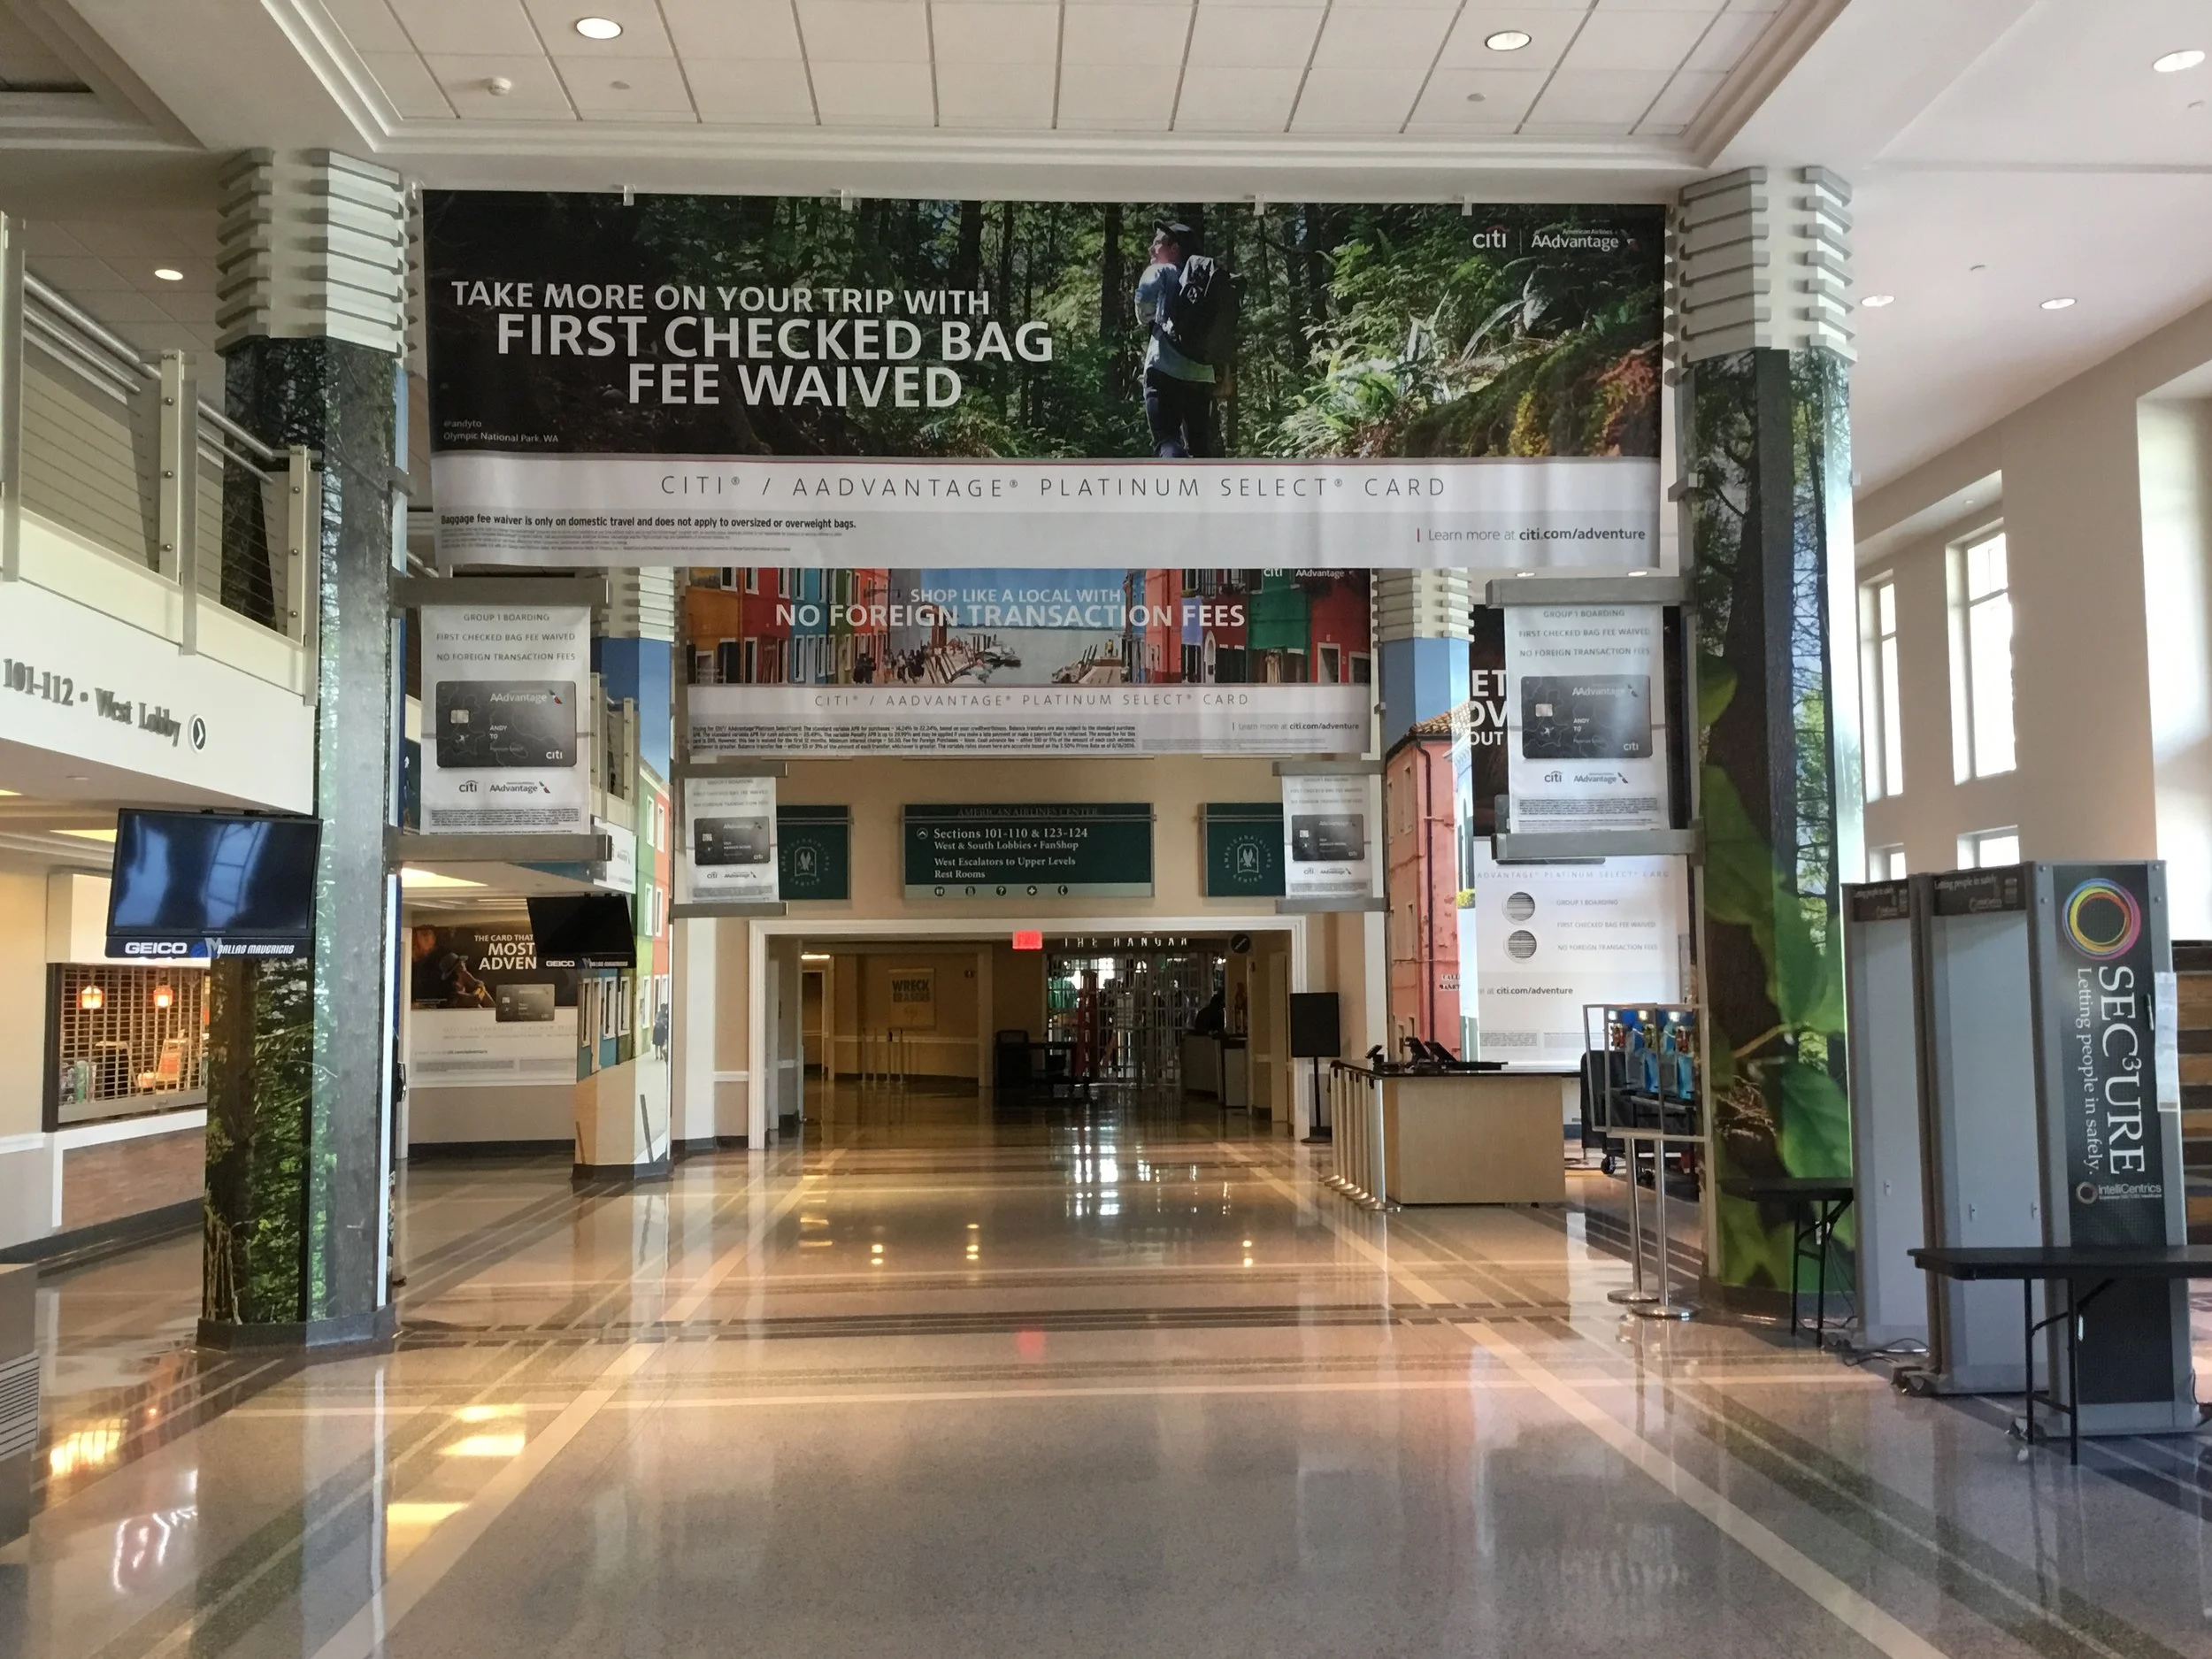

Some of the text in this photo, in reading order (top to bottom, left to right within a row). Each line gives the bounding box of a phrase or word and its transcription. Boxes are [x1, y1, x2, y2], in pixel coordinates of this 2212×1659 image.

[1472, 228, 1619, 252] citi AAdvantage
[451, 280, 989, 315] TAKE MORE ON YOUR TRIP WITH
[498, 313, 1053, 362] FIRST CHECKED BAG
[629, 363, 962, 408] FEE WAIVED
[443, 431, 478, 441] Olympic
[480, 432, 518, 442] National
[543, 434, 559, 443] WA
[762, 478, 771, 495] /
[1041, 478, 1199, 496] PLATINUM
[1364, 478, 1445, 497] CARD
[441, 513, 856, 530] Baggage fee waiver is only on domestic travel and does not apply to oversized or overweight bags.
[1428, 526, 1646, 542] Learn more at citi.com/adventure
[1295, 569, 1345, 580] AAdvantage
[910, 588, 1121, 603] SHOP LIKE A LOCAL WITH
[464, 613, 495, 622] GROUP
[503, 613, 549, 622] BOARDING
[775, 603, 1245, 627] NO FOREIGN TRANSACTION FEES
[462, 633, 502, 641] CHECKED
[504, 633, 523, 641] BAG
[525, 633, 539, 641] FEE
[541, 633, 575, 641] WAIVED
[557, 652, 575, 661] FEES
[1534, 649, 1571, 657] FOREIGN
[1573, 648, 1631, 657] TRANSACTION
[1572, 687, 1626, 697] AAdvantage
[4, 657, 182, 748] 101-112 West Lobby
[490, 693, 548, 704] AAdvantage
[1023, 694, 1112, 706] PLATINUM
[1203, 694, 1248, 706] CARD
[1239, 722, 1258, 731] Learn
[1289, 722, 1360, 732] citi.com/adventure
[1623, 741, 1639, 752] citi
[545, 749, 563, 760] citi
[1544, 772, 1617, 785] citi AAdvantage
[459, 780, 538, 794] citi AAdvantage
[957, 807, 1011, 818] AMERICAN
[933, 827, 1088, 839] Sections 101-110 & 123-124
[934, 840, 1079, 852] West & South Lobbies FanShop
[934, 857, 956, 866] West
[958, 856, 1004, 866] Escalators
[1018, 857, 1047, 869] Upper
[1048, 856, 1077, 866] Levels
[934, 870, 986, 879] Rest Rooms
[125, 941, 296, 955] GEICO DALLAS MAVERICKS
[488, 942, 536, 956] MOST
[1064, 937, 1098, 949] THE
[479, 956, 537, 970] ADVEN
[892, 979, 930, 992] WRECK
[1496, 987, 1573, 995] citi.com/adventure
[2075, 968, 2103, 1175] Letting people in safely.
[2098, 1183, 2162, 1194] IntelliCentrics
